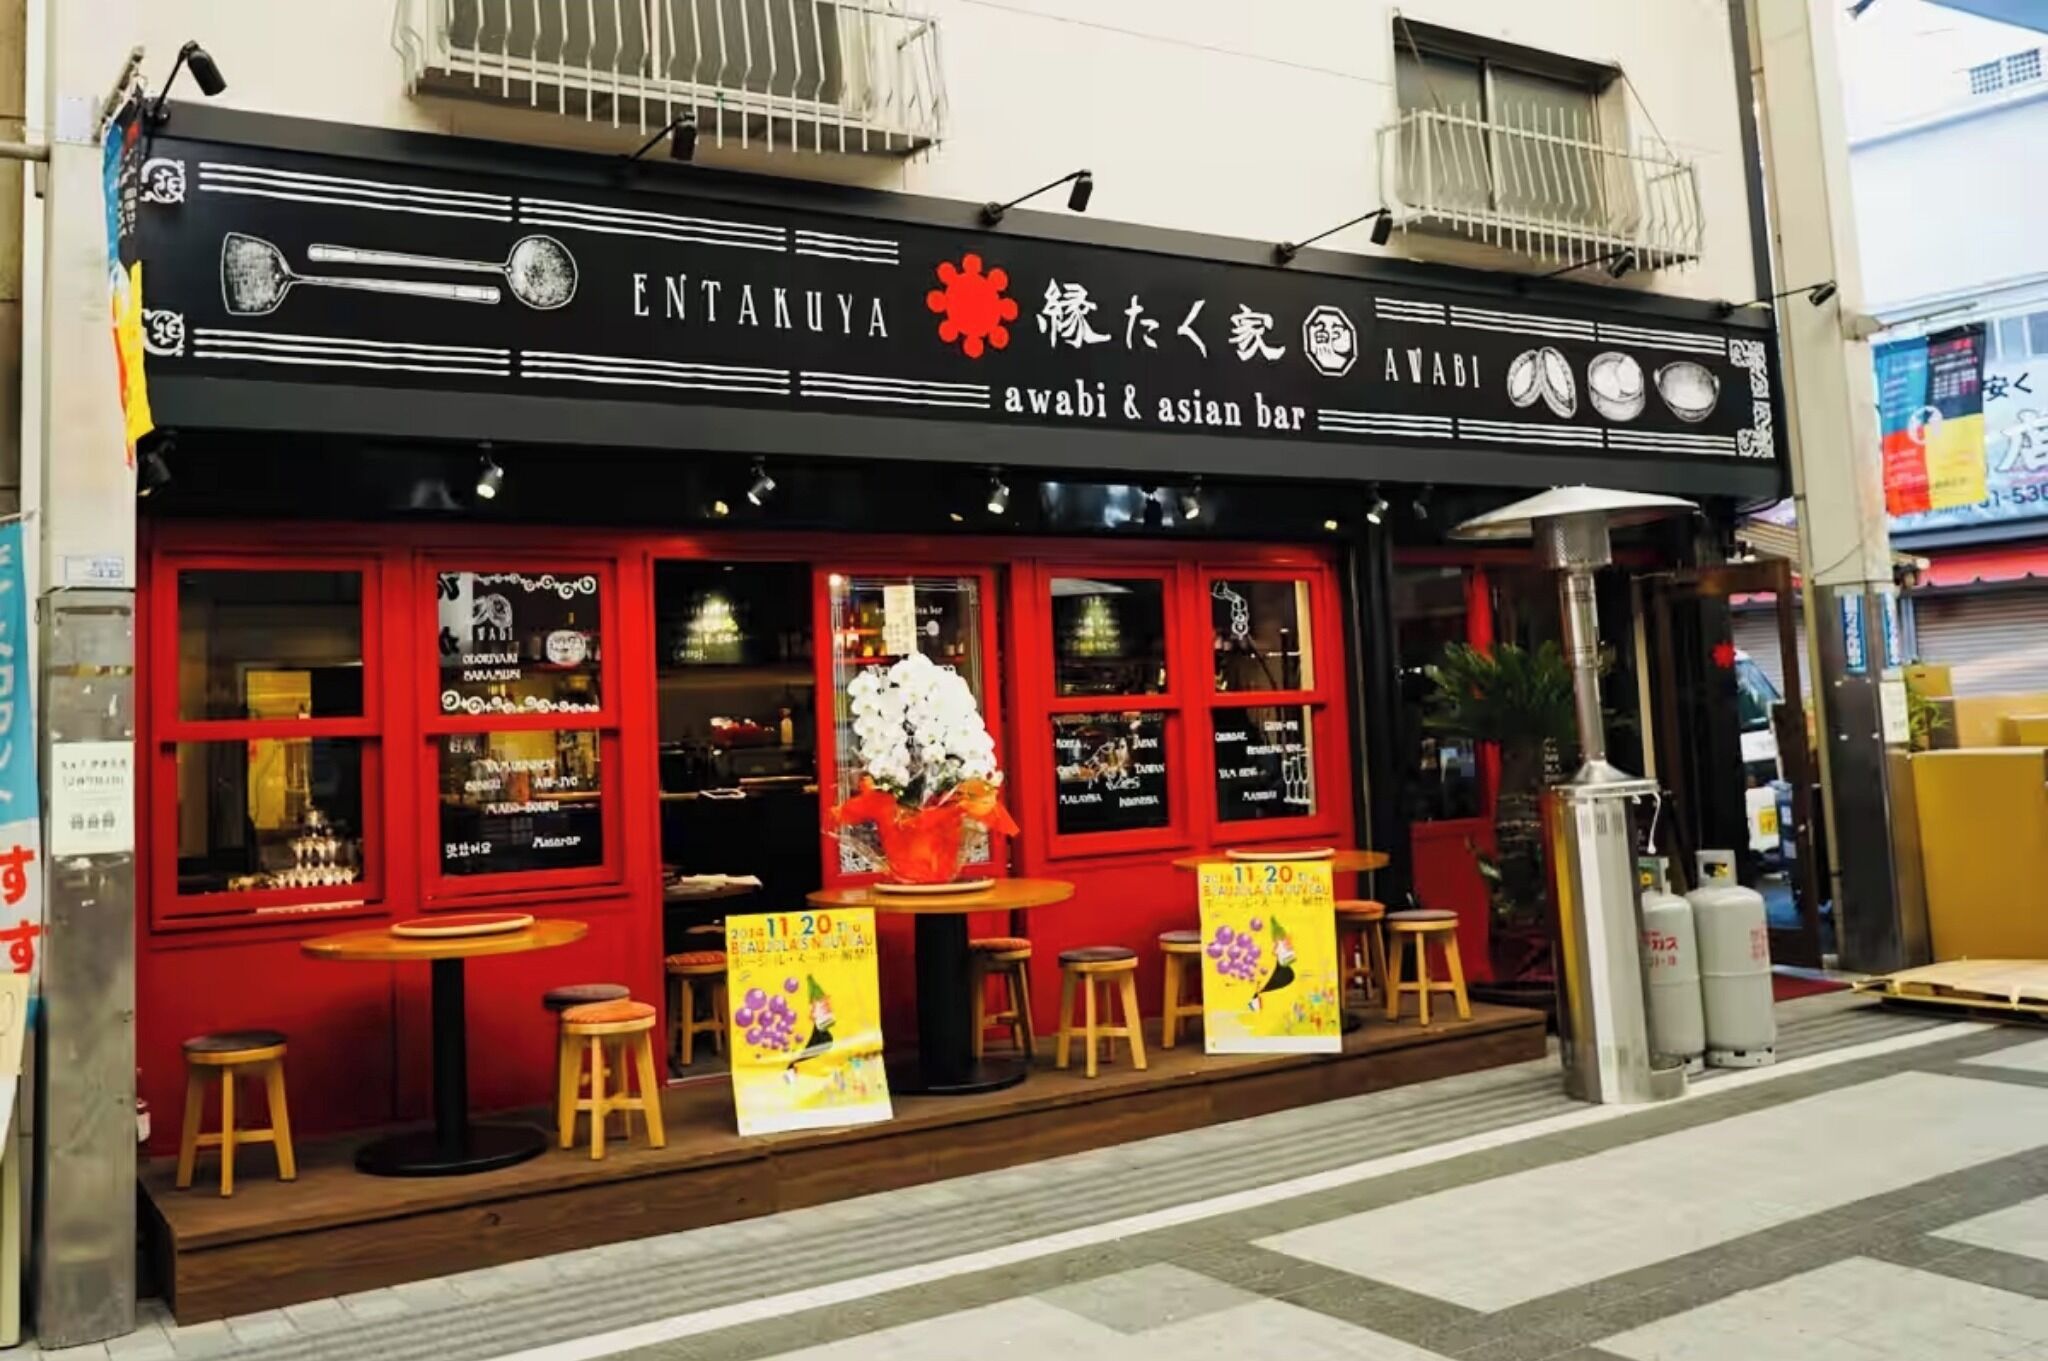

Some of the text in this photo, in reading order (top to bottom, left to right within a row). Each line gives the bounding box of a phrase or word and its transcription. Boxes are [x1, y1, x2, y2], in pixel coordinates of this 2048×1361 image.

[633, 273, 888, 338] ENTAKUYA
[1036, 278, 1286, 361] 縁たく家
[1385, 347, 1480, 388] AWABI
[1004, 378, 1305, 430] awabi & asian bar
